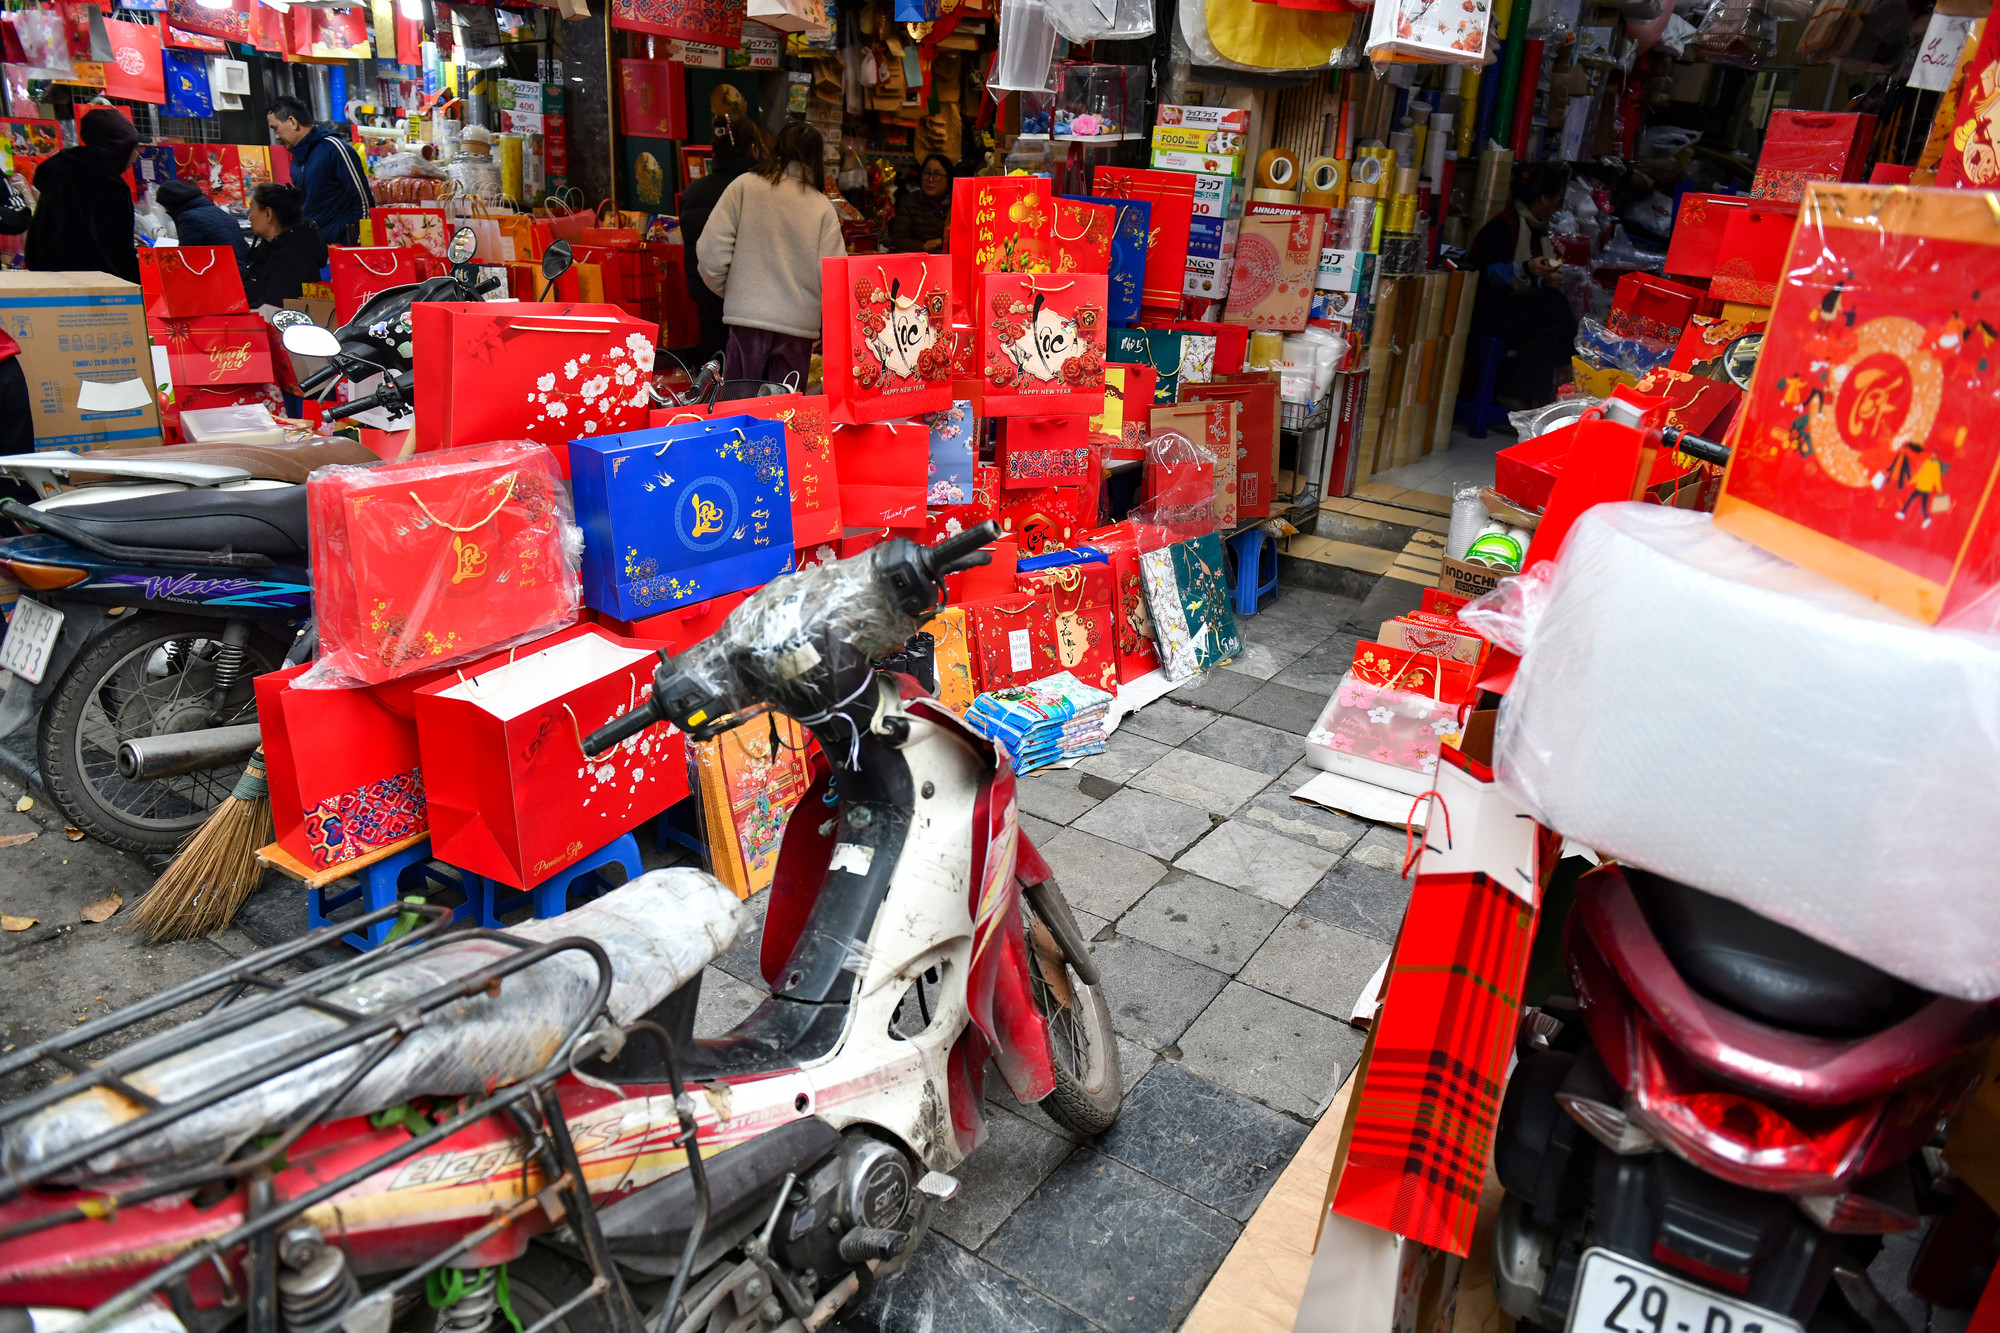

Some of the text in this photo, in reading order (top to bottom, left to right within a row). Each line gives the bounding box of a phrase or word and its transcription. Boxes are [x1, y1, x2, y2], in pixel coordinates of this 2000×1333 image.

[685, 54, 702, 64] 600
[754, 57, 772, 66] 400
[519, 102, 534, 111] 400
[1161, 135, 1185, 144] FOOD
[1252, 206, 1302, 215] ANNAPURNA
[1286, 251, 1309, 259] Happy
[891, 278, 922, 369] Lộc
[1032, 293, 1068, 375] Lộc
[206, 342, 251, 362] thank
[209, 360, 243, 381] you
[882, 384, 925, 396] HAPPY NEW YEAR
[1344, 375, 1355, 422] ANNAPURNA
[692, 493, 724, 538] Lộc
[880, 505, 916, 520] Thank you
[452, 536, 488, 584] Lộc
[145, 573, 263, 600] Wave
[166, 596, 199, 605] HONDA
[1603, 1273, 1764, 1333] 29-
